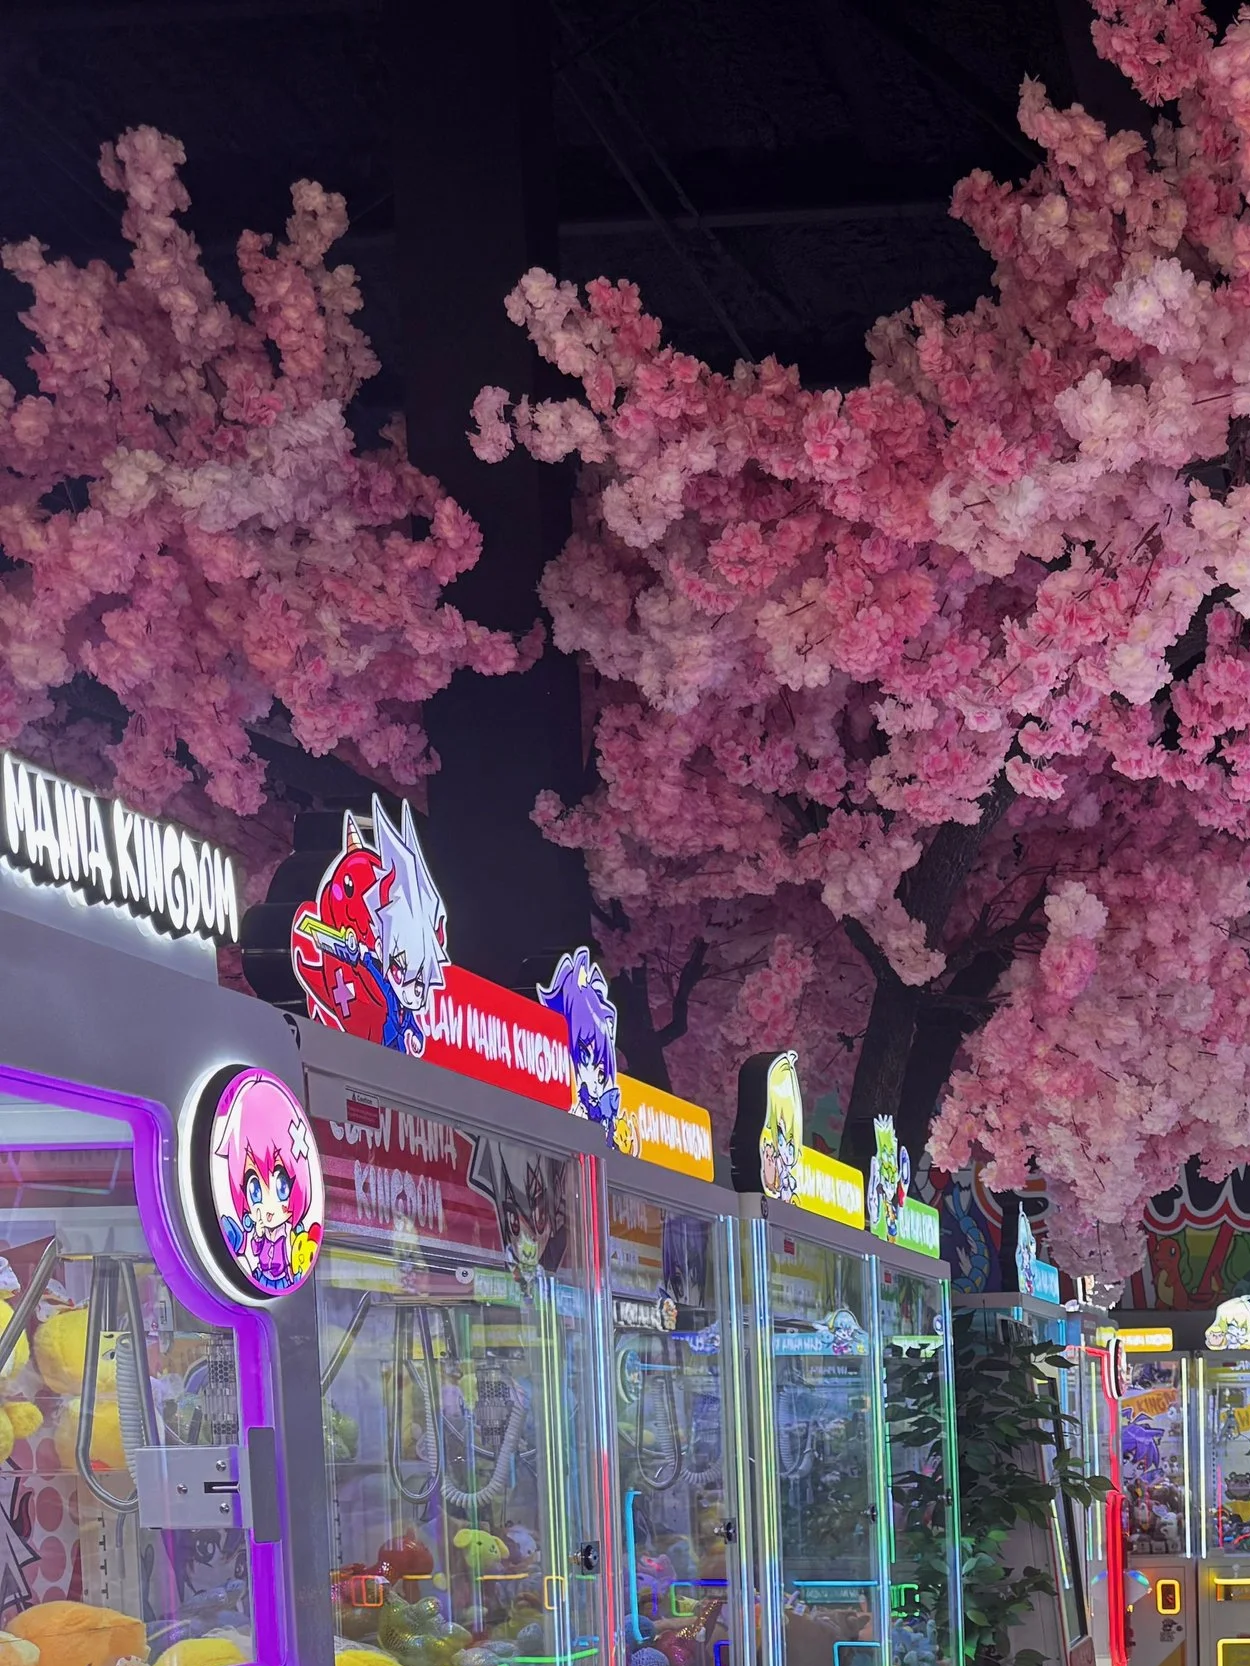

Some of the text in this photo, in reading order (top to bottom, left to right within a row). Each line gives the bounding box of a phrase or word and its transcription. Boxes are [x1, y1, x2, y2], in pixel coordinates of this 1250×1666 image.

[4, 751, 239, 944] MANIA KINGDOM
[466, 1004, 511, 1069] MANIA
[512, 1022, 571, 1087] KINGDOM
[398, 1111, 458, 1171] MANIA
[353, 1159, 446, 1234] KINGDOM
